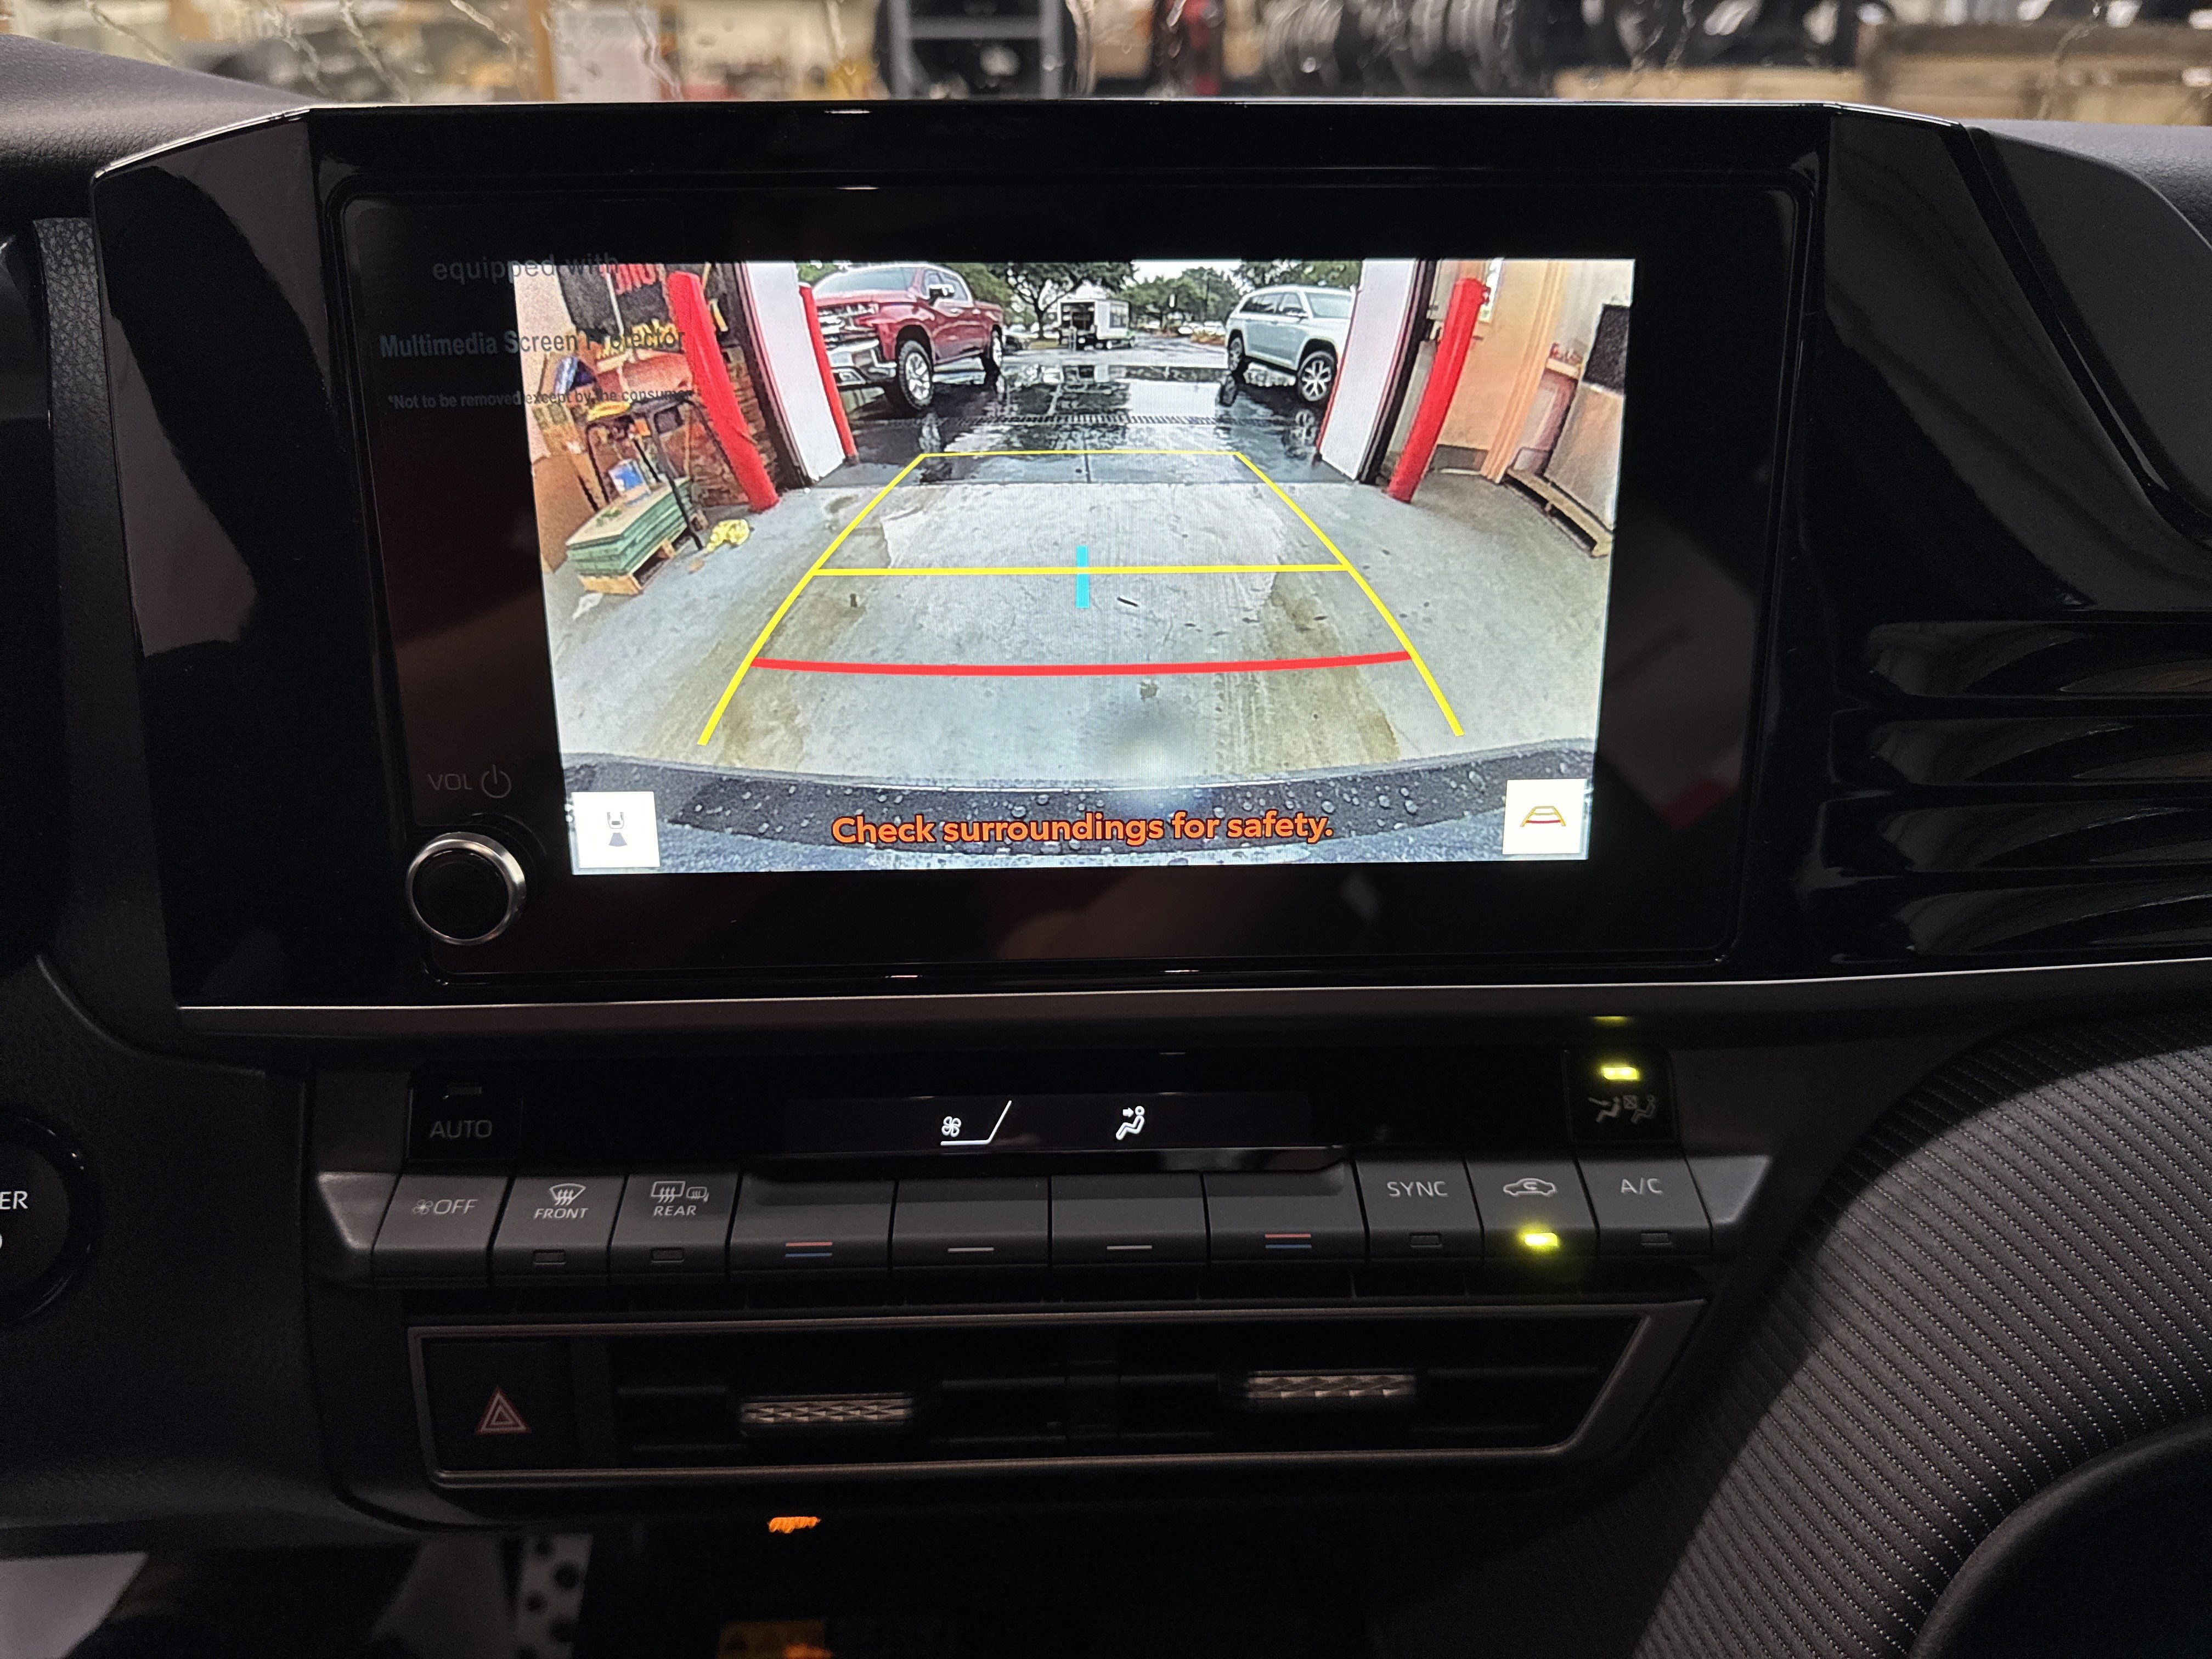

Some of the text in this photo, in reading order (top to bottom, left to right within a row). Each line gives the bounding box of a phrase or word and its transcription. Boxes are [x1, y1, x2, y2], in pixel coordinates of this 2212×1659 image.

[432, 252, 619, 285] equipped with
[379, 330, 685, 357] Multimedia Screen Potector
[422, 393, 437, 408] to
[439, 393, 458, 408] be
[460, 390, 522, 407] removed
[525, 392, 571, 404] except
[575, 388, 591, 405] by
[594, 389, 617, 402] he
[427, 772, 473, 791] VOL
[831, 810, 1334, 846] Check surroundings for safety.
[430, 1119, 493, 1138] AUTO
[1386, 1181, 1448, 1198] SYNC
[1620, 1177, 1663, 1195] A/C
[433, 1199, 478, 1215] OFF
[533, 1207, 589, 1219] FRONT
[653, 1205, 697, 1216] REAR
